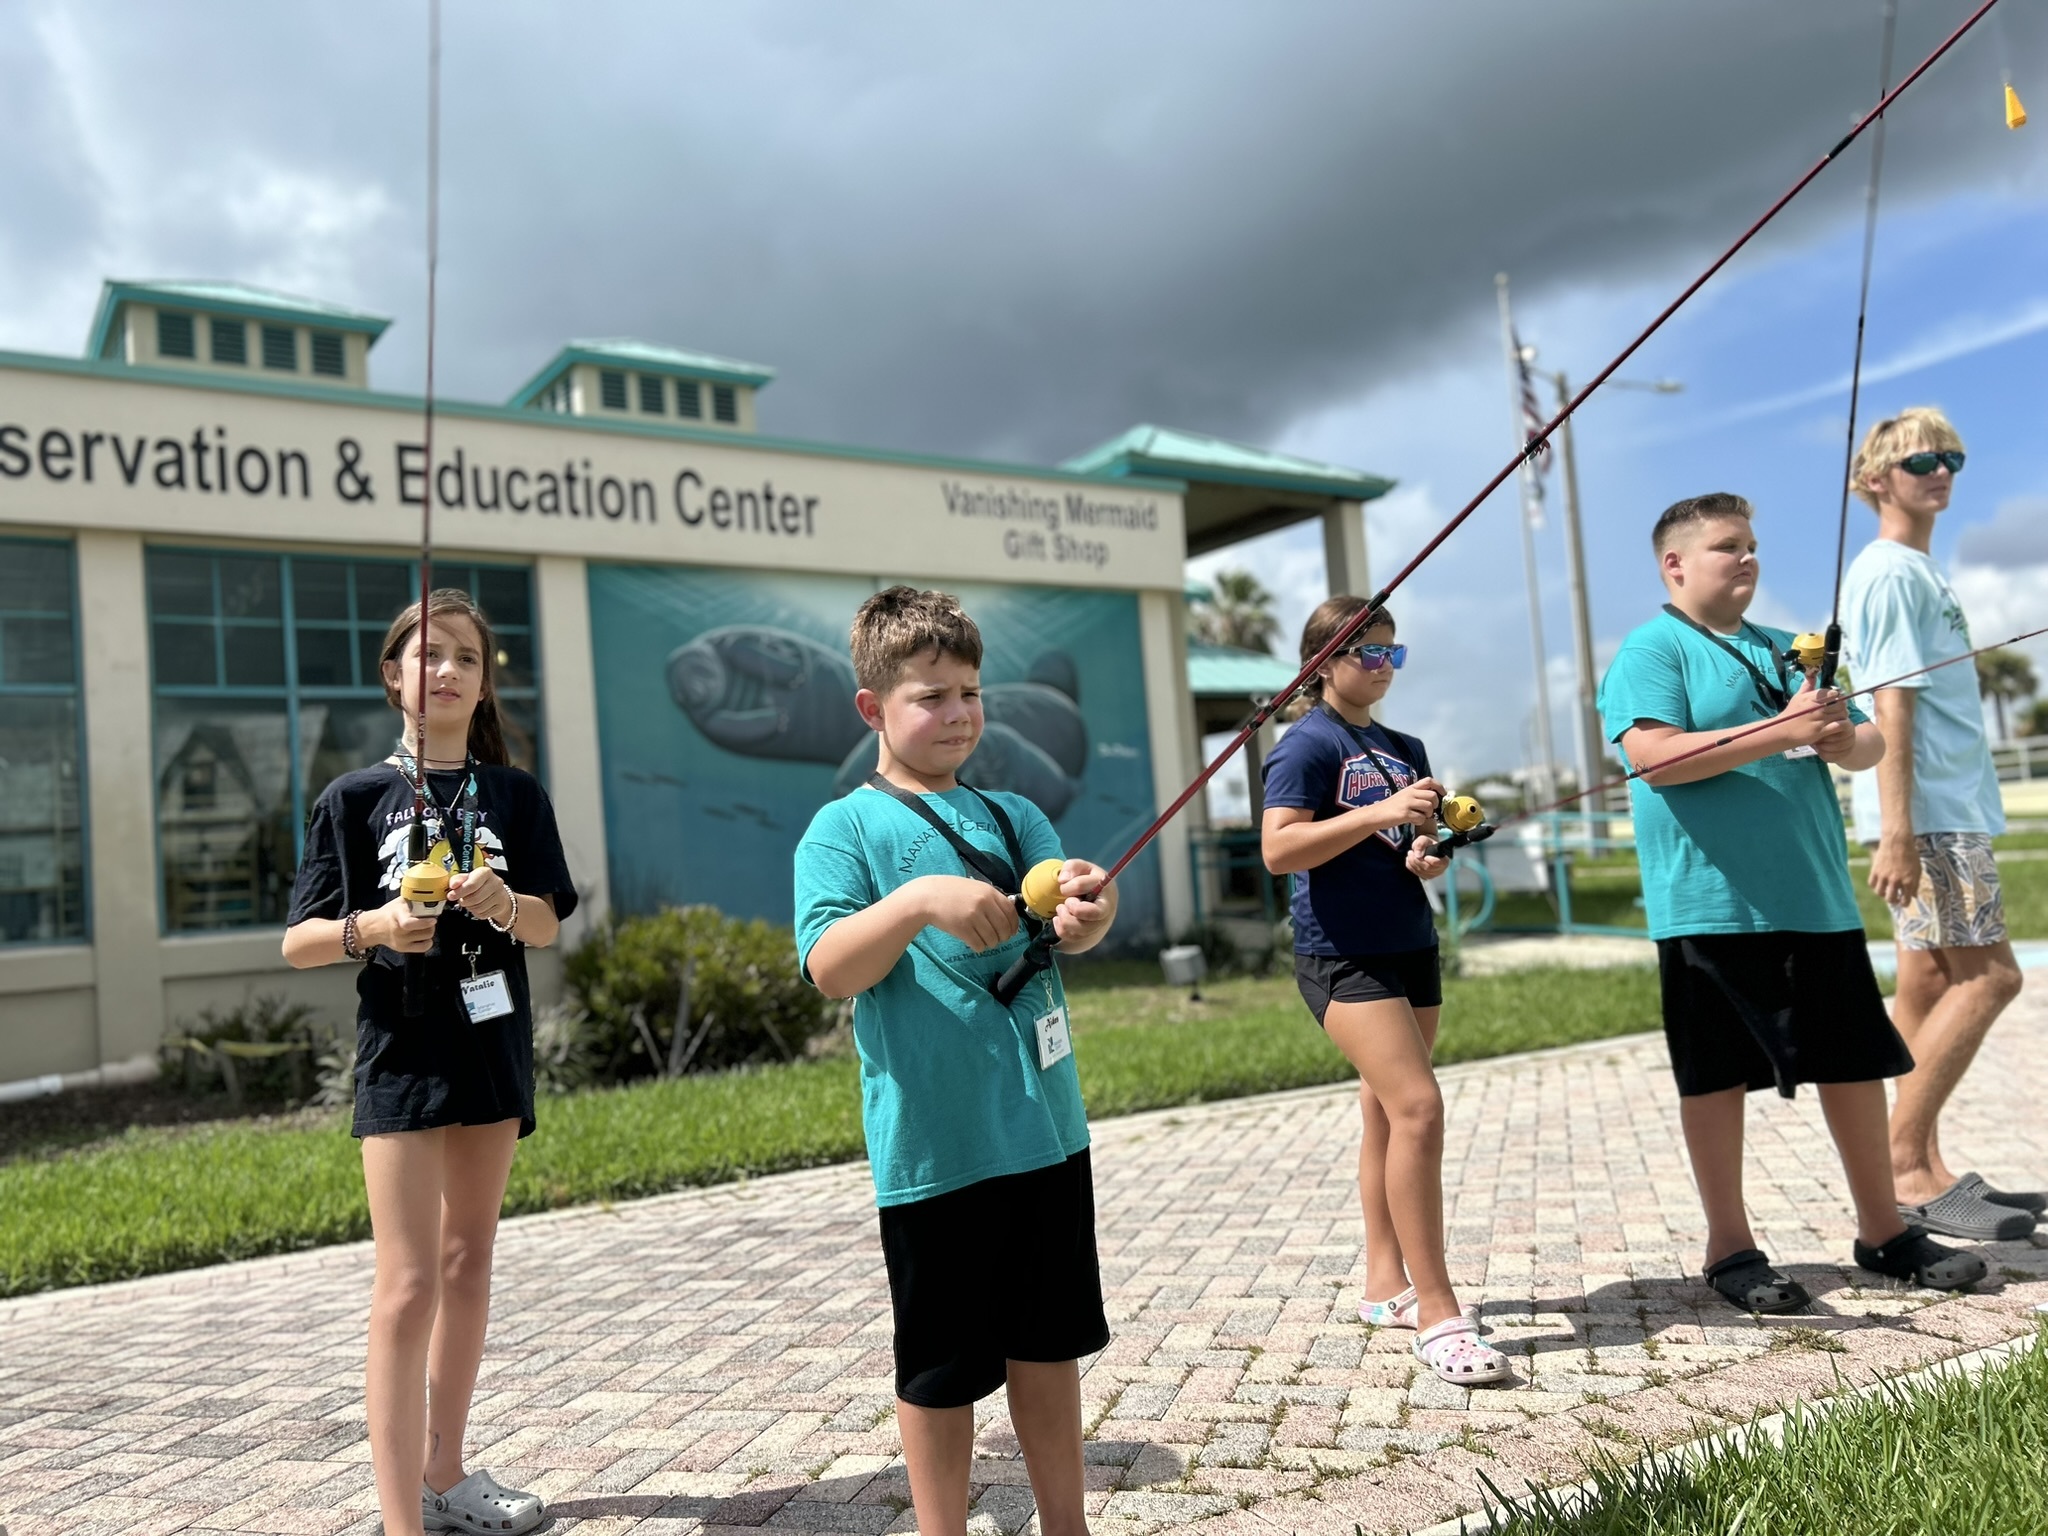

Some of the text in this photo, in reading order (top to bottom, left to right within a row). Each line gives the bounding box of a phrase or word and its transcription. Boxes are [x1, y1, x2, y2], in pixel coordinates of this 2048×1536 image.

[0, 424, 820, 537] servation & Education Center
[941, 479, 1159, 532] Vanishing Mermaid
[1003, 528, 1110, 570] Gift Shop
[456, 808, 488, 823] BY
[898, 821, 959, 874] MANATE
